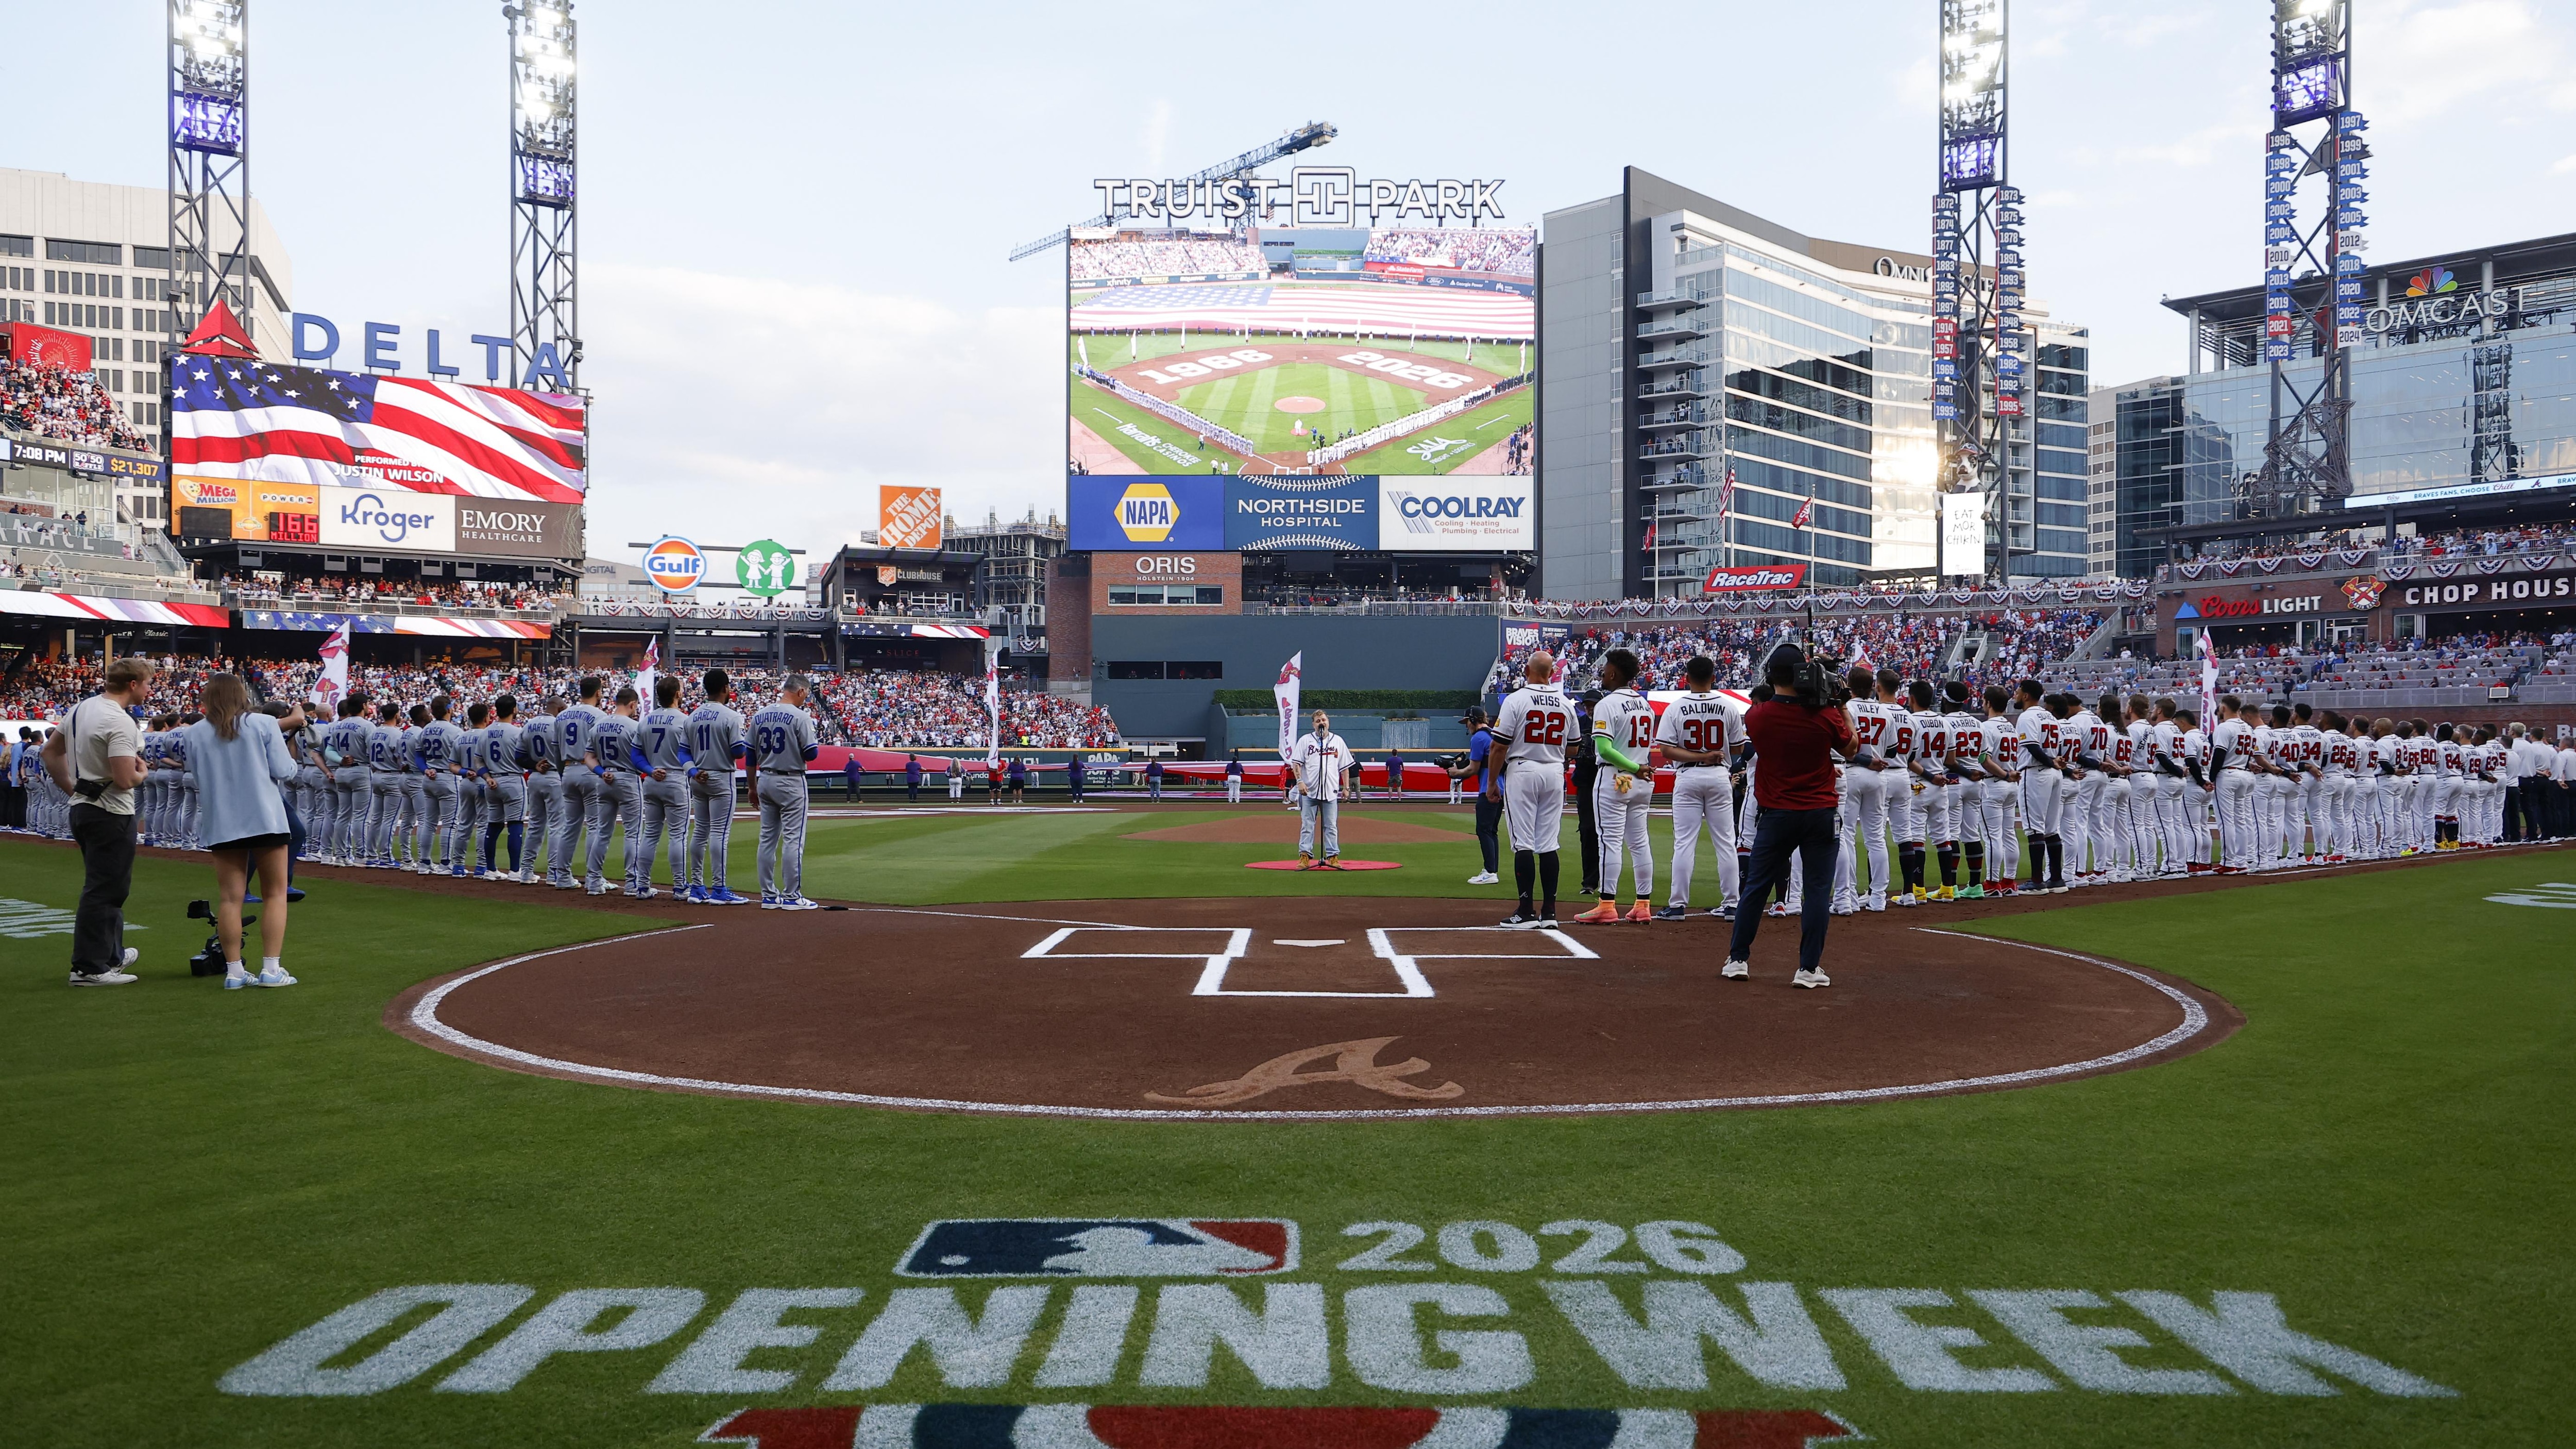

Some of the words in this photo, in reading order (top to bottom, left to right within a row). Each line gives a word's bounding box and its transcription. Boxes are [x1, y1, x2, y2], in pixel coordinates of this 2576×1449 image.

[2341, 115, 2361, 128] 1997
[2270, 134, 2290, 147] 1996
[2340, 139, 2361, 153] 1999
[2270, 157, 2290, 171] 1998
[2340, 163, 2361, 176] 2001
[2270, 180, 2291, 193] 2000
[2340, 187, 2362, 200] 2003
[1094, 178, 1280, 219] TRUIST
[1369, 179, 1506, 219] PARK
[2000, 190, 2018, 201] 1873
[1937, 198, 1954, 209] 1872
[2270, 204, 2290, 216] 2002
[2000, 211, 2018, 222] 1875
[2340, 211, 2361, 224] 2005
[1937, 219, 1954, 229] 1874
[2000, 232, 2018, 243] 1878
[2269, 226, 2290, 239] 2004
[1937, 240, 1954, 250] 1877
[2340, 235, 2360, 247] 2012
[2000, 254, 2018, 264] 1891
[2270, 250, 2289, 262] 2010
[1937, 260, 1955, 271] 1883
[2340, 259, 2360, 272] 2018
[2000, 275, 2019, 285] 1893
[2269, 273, 2289, 285] 2013
[1936, 281, 1955, 292] 1892
[2340, 283, 2360, 295] 2020
[1936, 302, 1954, 313] 1897
[1999, 295, 2018, 307] 1898
[2269, 297, 2289, 309] 2019
[2339, 307, 2360, 319] 2022
[1936, 323, 1954, 333] 1914
[1999, 316, 2018, 328] 1948
[2269, 320, 2288, 332] 2021
[2340, 330, 2359, 342] 2024
[292, 312, 570, 387] DELTA
[1936, 343, 1954, 354] 1957
[1999, 338, 2018, 349] 1958
[2269, 345, 2288, 357] 2023
[1137, 349, 1274, 385] 1966
[1337, 351, 1476, 389] 2026
[1936, 364, 1955, 375] 1969
[1999, 358, 2018, 369] 1982
[1936, 384, 1954, 396] 1991
[1999, 379, 2018, 390] 1992
[1936, 405, 1954, 416] 1993
[1999, 400, 2018, 412] 1995
[14, 445, 43, 460] 7:08
[45, 449, 66, 464] PM
[1153, 446, 1193, 468] CASINOS
[1162, 442, 1202, 463] CHEROKEE
[111, 458, 159, 477] $21,307
[355, 456, 409, 467] PERFORMED
[334, 465, 384, 480] JUSTIN
[388, 468, 444, 484] WILSON
[199, 483, 236, 497] MEGA
[885, 492, 912, 517] THE
[1238, 499, 1365, 514] NORTHSIDE
[1400, 496, 1526, 518] COOLRAY
[342, 494, 434, 542] Kroger
[879, 486, 941, 547] HOME
[1126, 501, 1169, 525] NAPA
[1954, 509, 1974, 520] EAT
[279, 513, 318, 533] 166
[461, 509, 546, 533] EMORY
[1261, 517, 1342, 527] HOSPITAL
[1953, 520, 1975, 532] MOR
[903, 510, 941, 548] DEPOT
[270, 531, 317, 543] MILLION
[462, 531, 542, 543] HEALTHCARE
[1946, 533, 1980, 545] CHIKIN
[648, 556, 701, 573] Gulf
[1136, 557, 1196, 574] ORIS
[897, 570, 942, 581] CLUBHOUSE
[1711, 570, 1794, 587] RaceTrac
[2405, 583, 2479, 604] CHOP
[2200, 595, 2262, 617] Coors
[2263, 596, 2322, 614] LIGHT
[145, 629, 168, 637] Classic
[1506, 628, 1539, 638] BRAVES
[1530, 695, 1560, 707] WEISS
[1681, 702, 1725, 716] BALDWIN
[1858, 704, 1879, 714] RILEY
[555, 710, 596, 726] PASQUANTINO
[693, 711, 719, 722] GARCIA
[754, 712, 794, 726] QUATRARO
[1951, 717, 1976, 730] HARRIS
[488, 730, 504, 739] INDIA
[528, 723, 550, 733] MARTE
[566, 722, 578, 746] 9
[596, 723, 625, 734] THOMAS
[1524, 710, 1566, 746] 22
[1628, 716, 1651, 748] 13
[1683, 719, 1724, 750] 30
[1858, 716, 1886, 746] 27
[336, 733, 349, 751] 14
[652, 728, 666, 753] 7
[697, 724, 710, 751] 11
[758, 727, 786, 754] 33
[2041, 724, 2059, 749] 75
[2090, 727, 2108, 750] 70
[422, 738, 443, 759] 22
[532, 735, 545, 757] 0
[599, 736, 619, 761] 15
[1921, 732, 1945, 758] 14
[1956, 731, 1982, 757] 23
[1998, 737, 2018, 762] 99
[2062, 739, 2081, 762] 72
[2115, 739, 2132, 762] 66
[2172, 737, 2184, 758] 55
[2235, 735, 2251, 755] 52
[371, 743, 384, 762] 12
[490, 740, 501, 763] 6
[2279, 744, 2300, 762] 40
[2300, 742, 2321, 761] 34
[2330, 745, 2347, 763] 26
[2421, 748, 2437, 765] 80
[1334, 1220, 1748, 1277] 2026
[216, 1282, 1537, 1397] OPENING
[1546, 1280, 2463, 1397] WEEK
